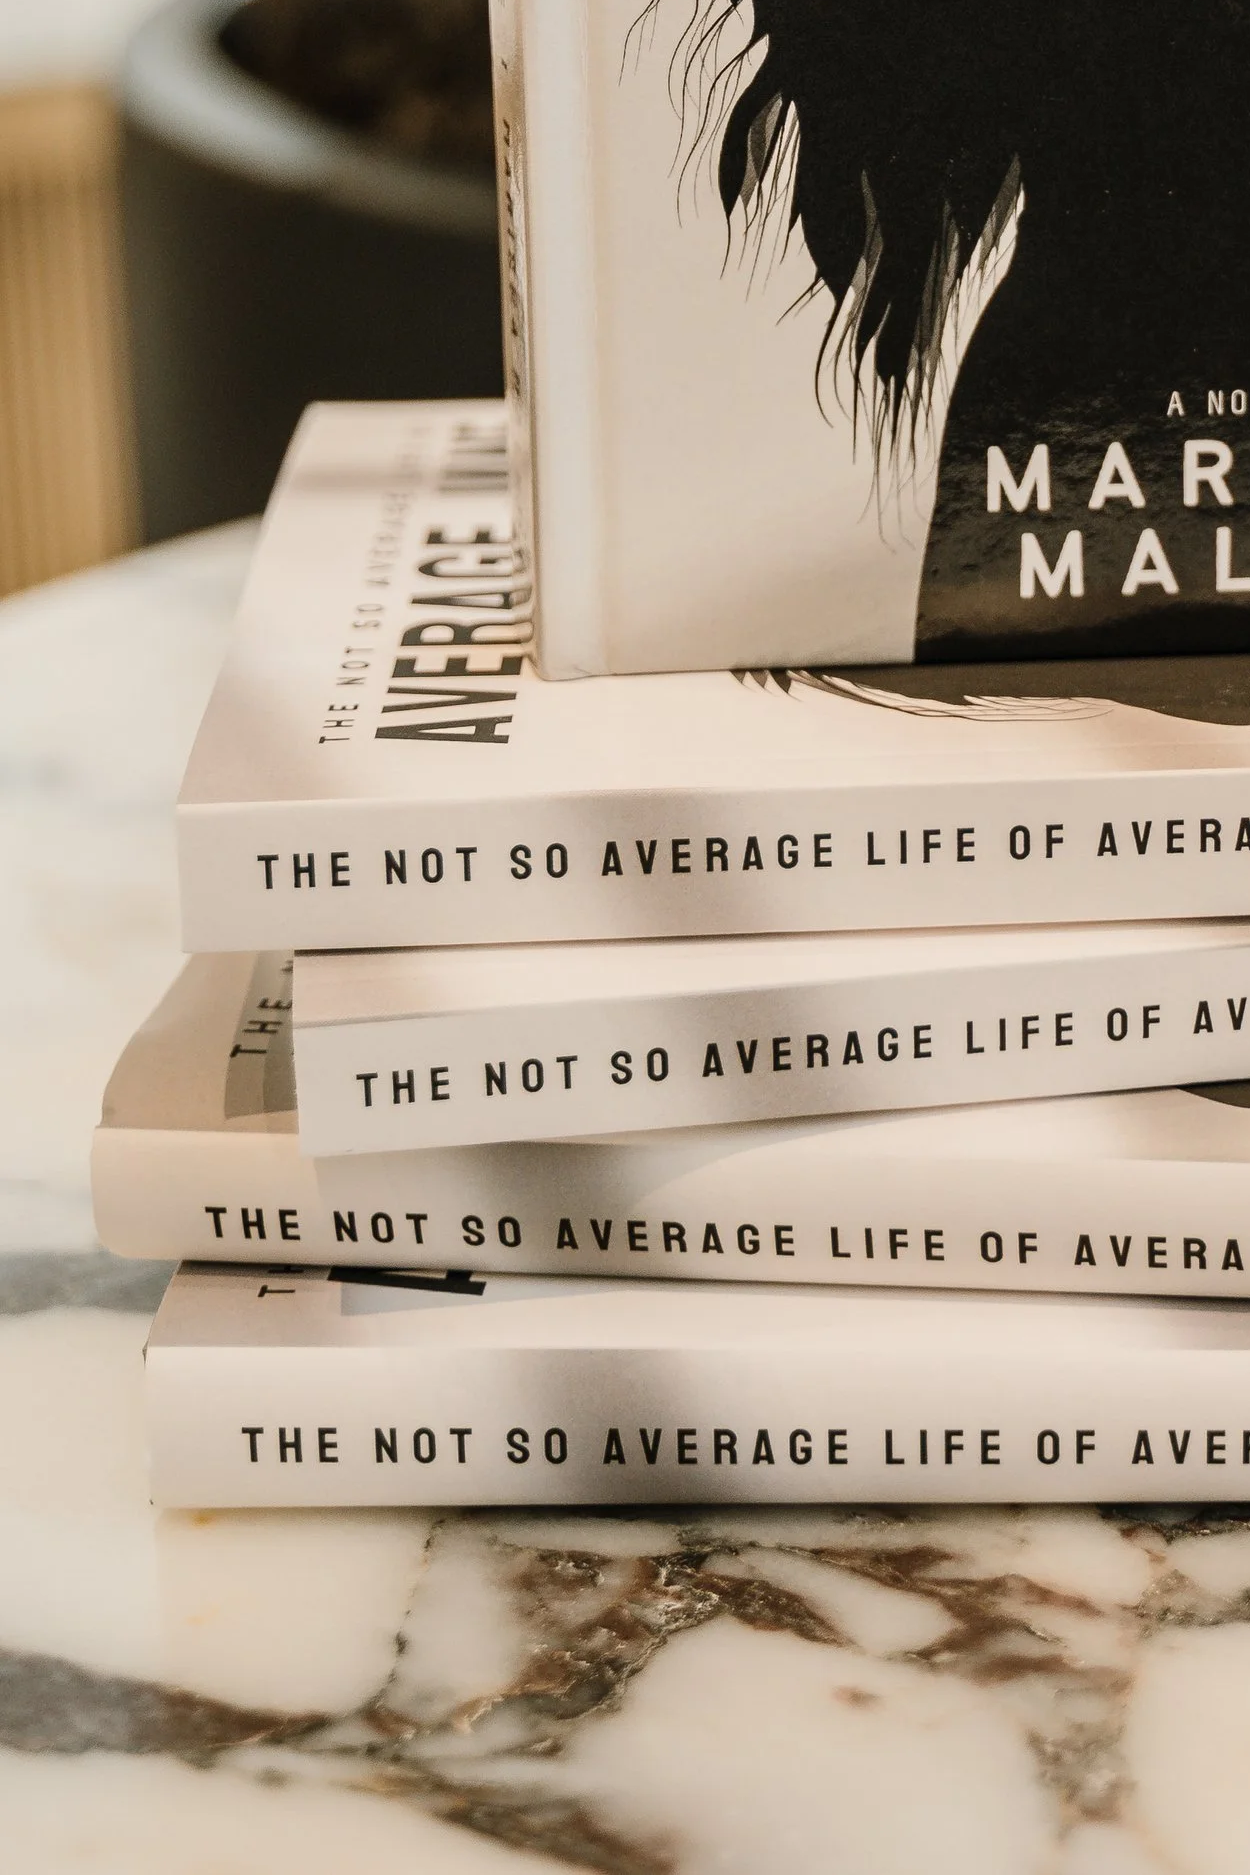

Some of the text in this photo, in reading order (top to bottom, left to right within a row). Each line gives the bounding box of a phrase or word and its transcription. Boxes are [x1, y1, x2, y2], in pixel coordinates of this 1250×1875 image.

[1166, 390, 1185, 416] A
[351, 602, 386, 630] SO
[374, 525, 527, 745] AVERAGE
[335, 645, 375, 686] NOT
[317, 702, 360, 745] THE
[256, 851, 351, 890] THE
[384, 846, 478, 886] NOT
[509, 842, 569, 881] SO
[601, 832, 833, 877] AVERAGE
[866, 826, 976, 866] LIFE
[1009, 823, 1064, 861] OF
[229, 996, 293, 1059] THE
[355, 1065, 451, 1108] THE
[484, 1054, 579, 1097] NOT
[610, 1046, 670, 1086] SO
[701, 1023, 933, 1078] AVERAGE
[966, 1011, 1074, 1055] LIFE
[1106, 1004, 1161, 1042] OF
[204, 1205, 301, 1241] THE
[332, 1210, 429, 1245] NOT
[461, 1214, 522, 1248] SO
[556, 1217, 796, 1257] AVERAGE
[829, 1225, 945, 1262] LIFE
[979, 1230, 1038, 1265] OF
[240, 1426, 340, 1464] THE
[374, 1426, 473, 1465] NOT
[505, 1426, 568, 1465] SO
[602, 1427, 849, 1466] AVERAGE
[884, 1428, 1001, 1466] LIFE
[1036, 1428, 1096, 1466] OF
